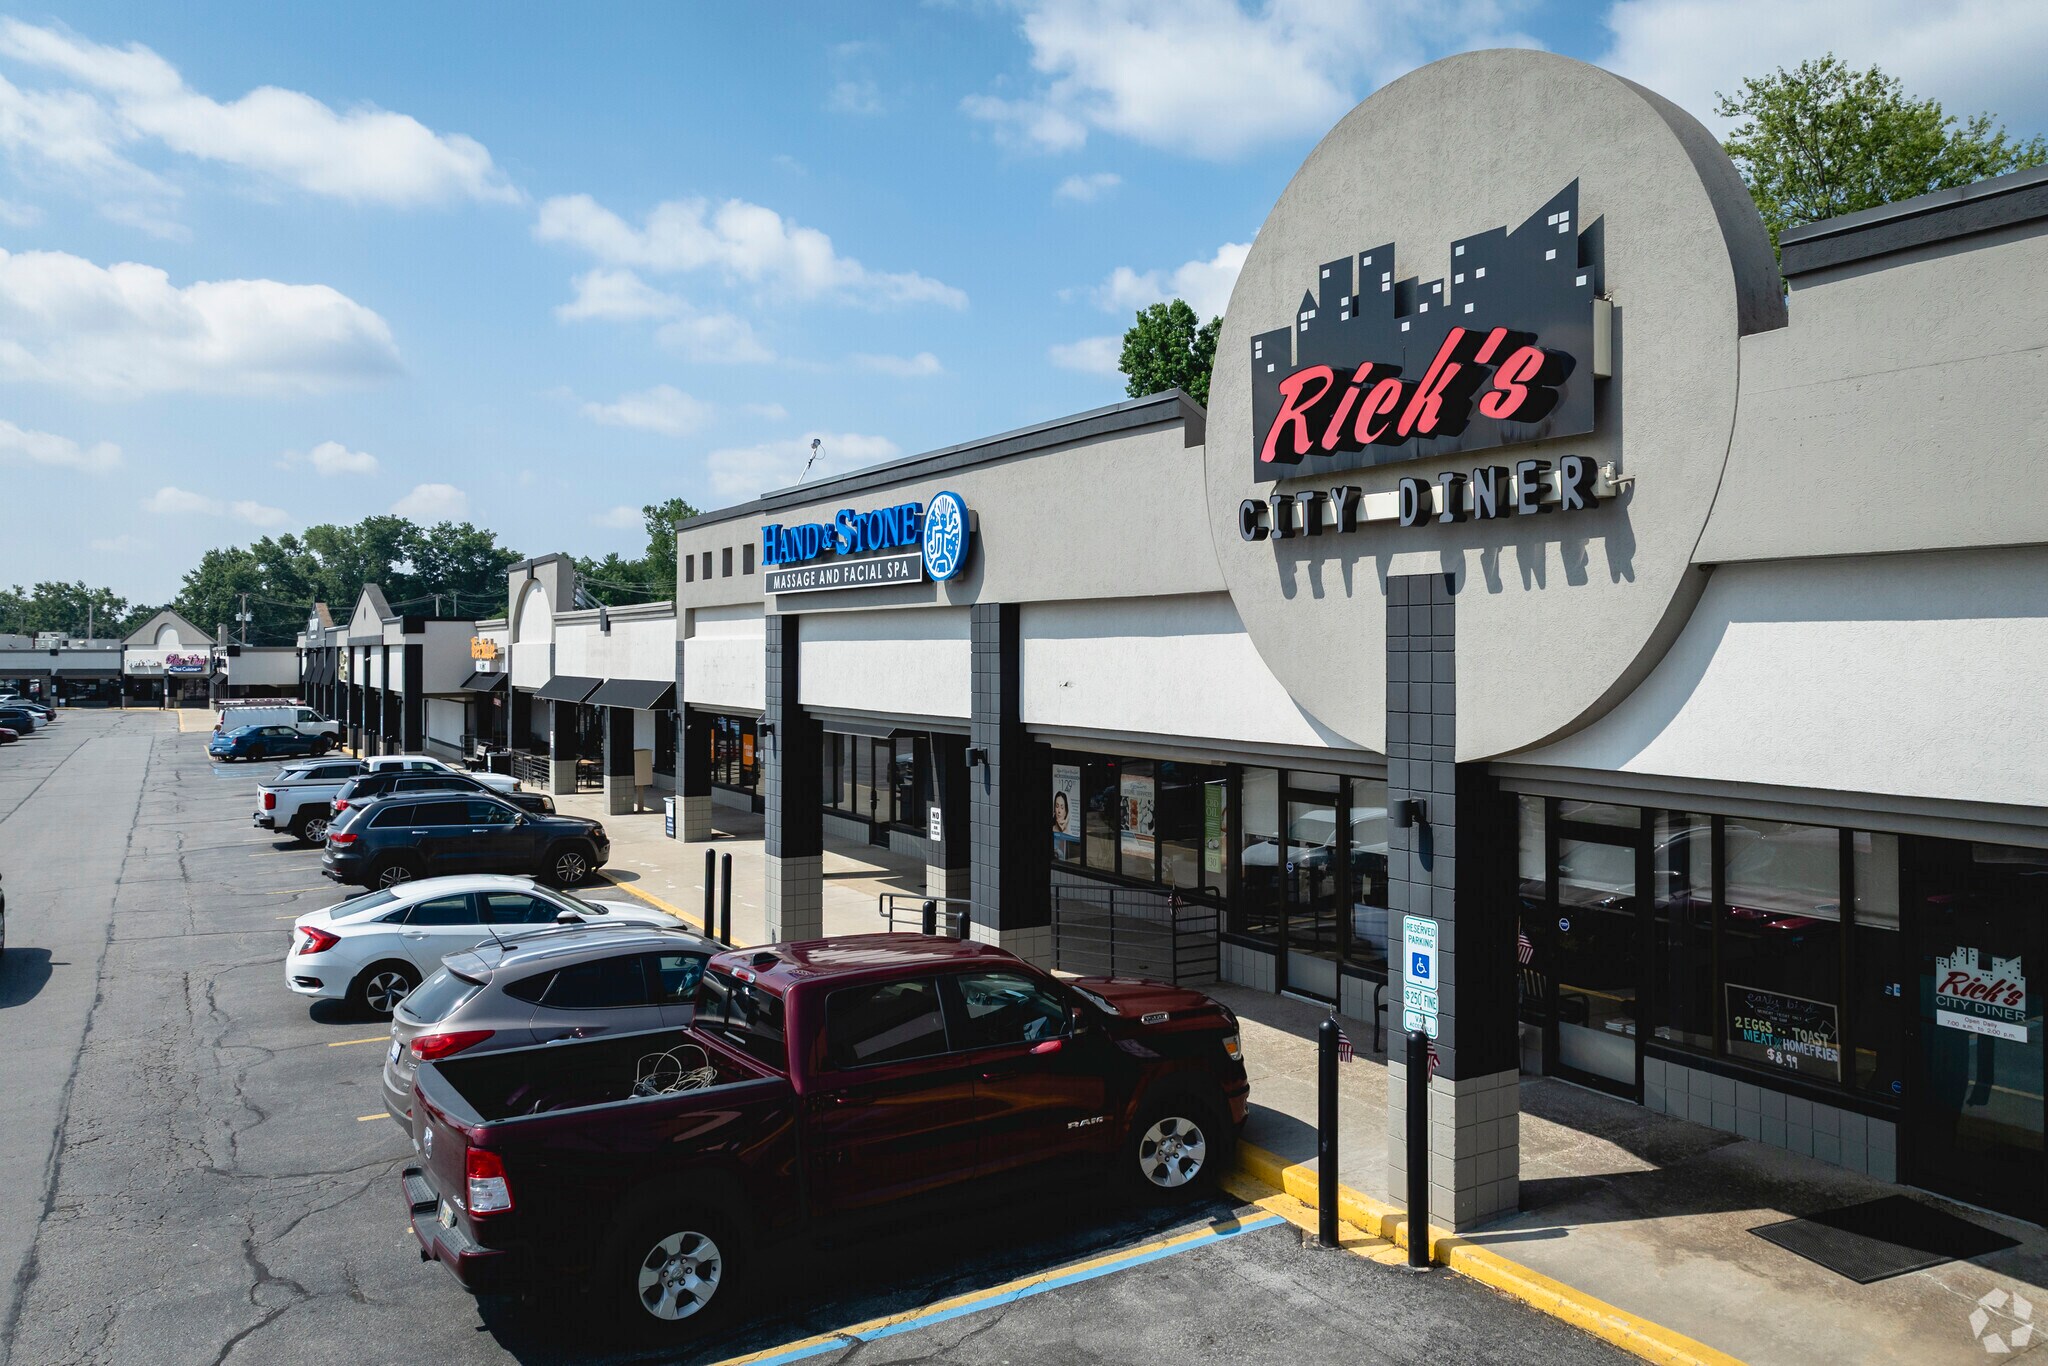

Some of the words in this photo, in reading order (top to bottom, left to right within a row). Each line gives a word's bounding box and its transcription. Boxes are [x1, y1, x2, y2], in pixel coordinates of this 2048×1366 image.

[1259, 325, 1556, 464] Rick's
[1238, 485, 1361, 542] CITY
[1398, 455, 1598, 529] DINER
[762, 523, 824, 565] HAND
[835, 502, 923, 555] STONE
[773, 571, 816, 590] MASSAGE
[819, 568, 840, 585] AND
[844, 563, 883, 582] FACIAL
[887, 560, 909, 578] SPA
[1206, 799, 1219, 807] CBD
[1206, 807, 1218, 817] OIL
[932, 811, 939, 819] NO
[1406, 922, 1435, 937] RESERVED
[1408, 934, 1434, 949] PARKING
[1938, 971, 2024, 1006] Rick's
[1424, 994, 1437, 1010] FINE
[1936, 996, 1970, 1010] CITY
[1975, 1004, 2026, 1022] DINER
[1735, 1016, 1743, 1028] 2
[1744, 1017, 1773, 1034] EGGS
[1792, 1027, 1829, 1048] TOAST
[1964, 1017, 1980, 1025] Open
[1982, 1020, 1997, 1029] Daily
[2003, 1031, 2016, 1039] p.m.
[1743, 1029, 1773, 1046] MEAT
[1782, 1038, 1839, 1062] HOMEFRIES
[1766, 1048, 1798, 1069] $8.99
[1067, 1115, 1104, 1129] RAM
